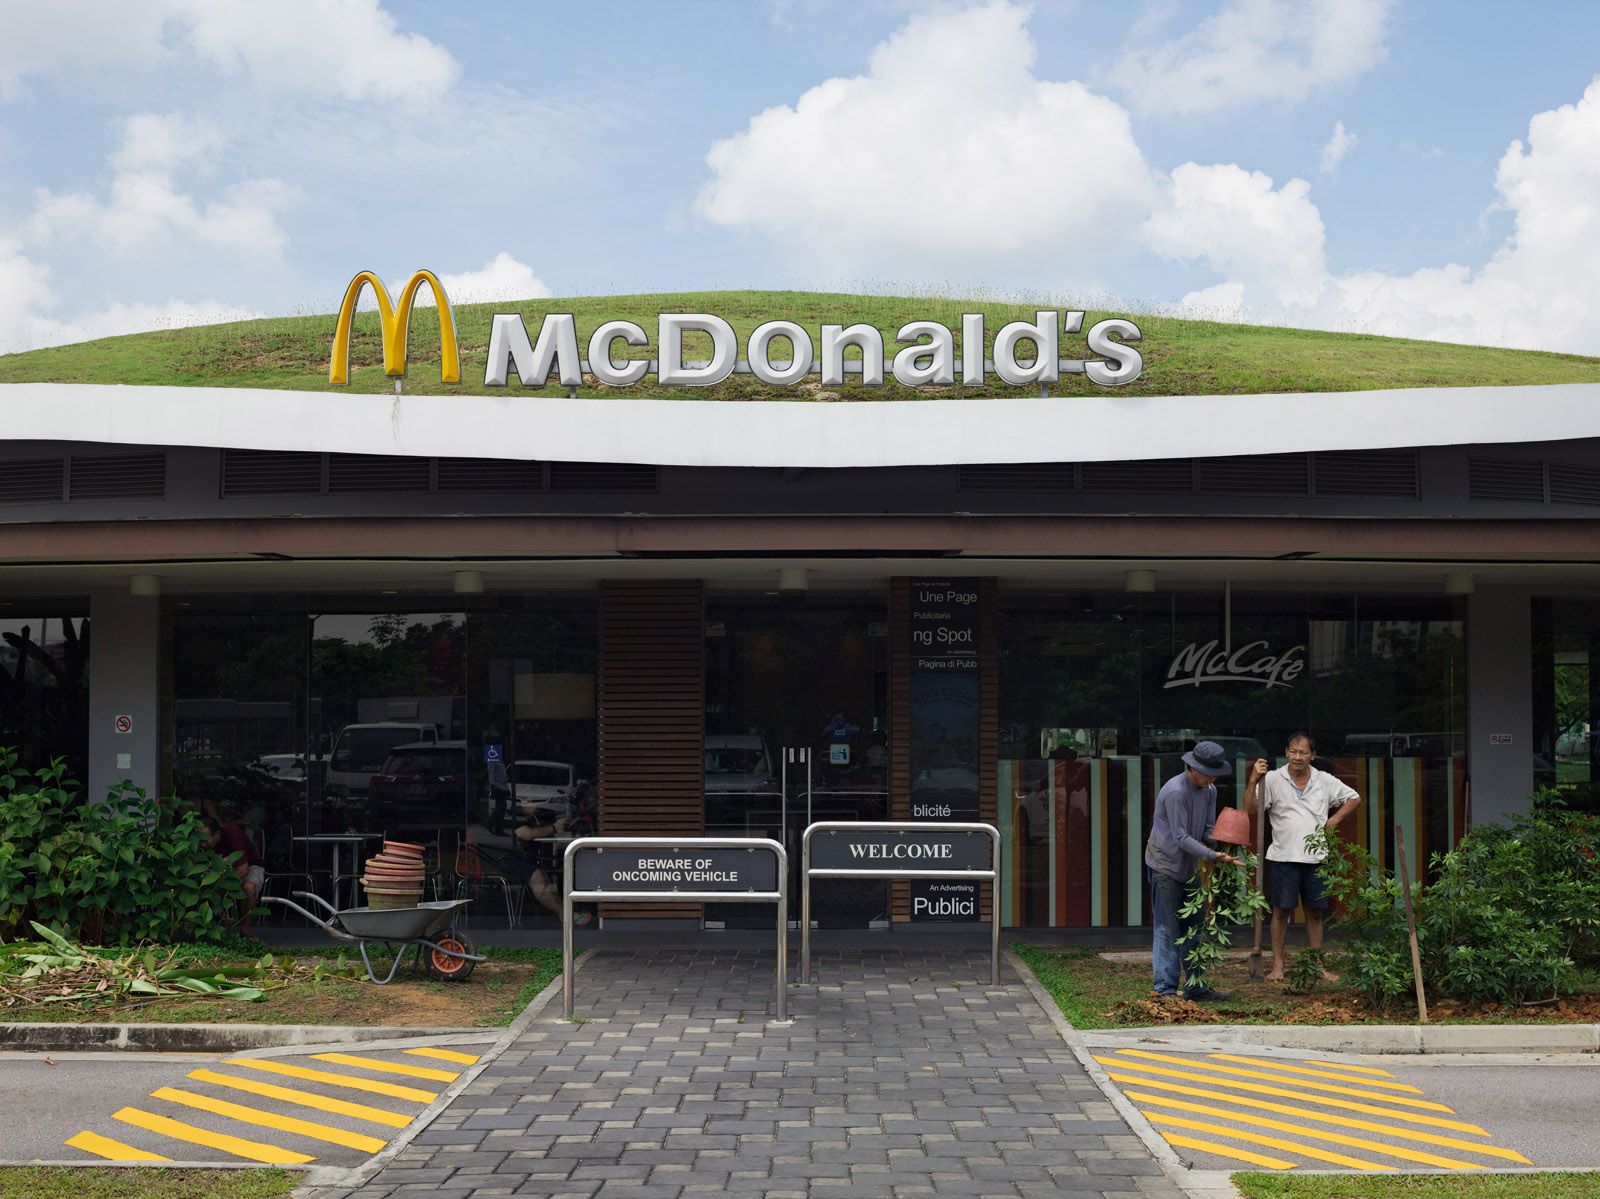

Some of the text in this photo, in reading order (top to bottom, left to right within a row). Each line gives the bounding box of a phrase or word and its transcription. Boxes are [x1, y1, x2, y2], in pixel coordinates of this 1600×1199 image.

[483, 310, 1144, 386] McDonald's
[920, 591, 977, 604] Une Page
[913, 626, 973, 646] ng Spot
[918, 659, 946, 670] Pagina
[947, 659, 955, 668] di
[913, 804, 952, 817] blicité
[849, 843, 953, 859] WELCOME
[637, 858, 713, 870] BEWARE OF
[612, 871, 738, 882] ONCOMING VEHICLE
[929, 884, 975, 893] An Advertising
[913, 897, 974, 915] Publici
